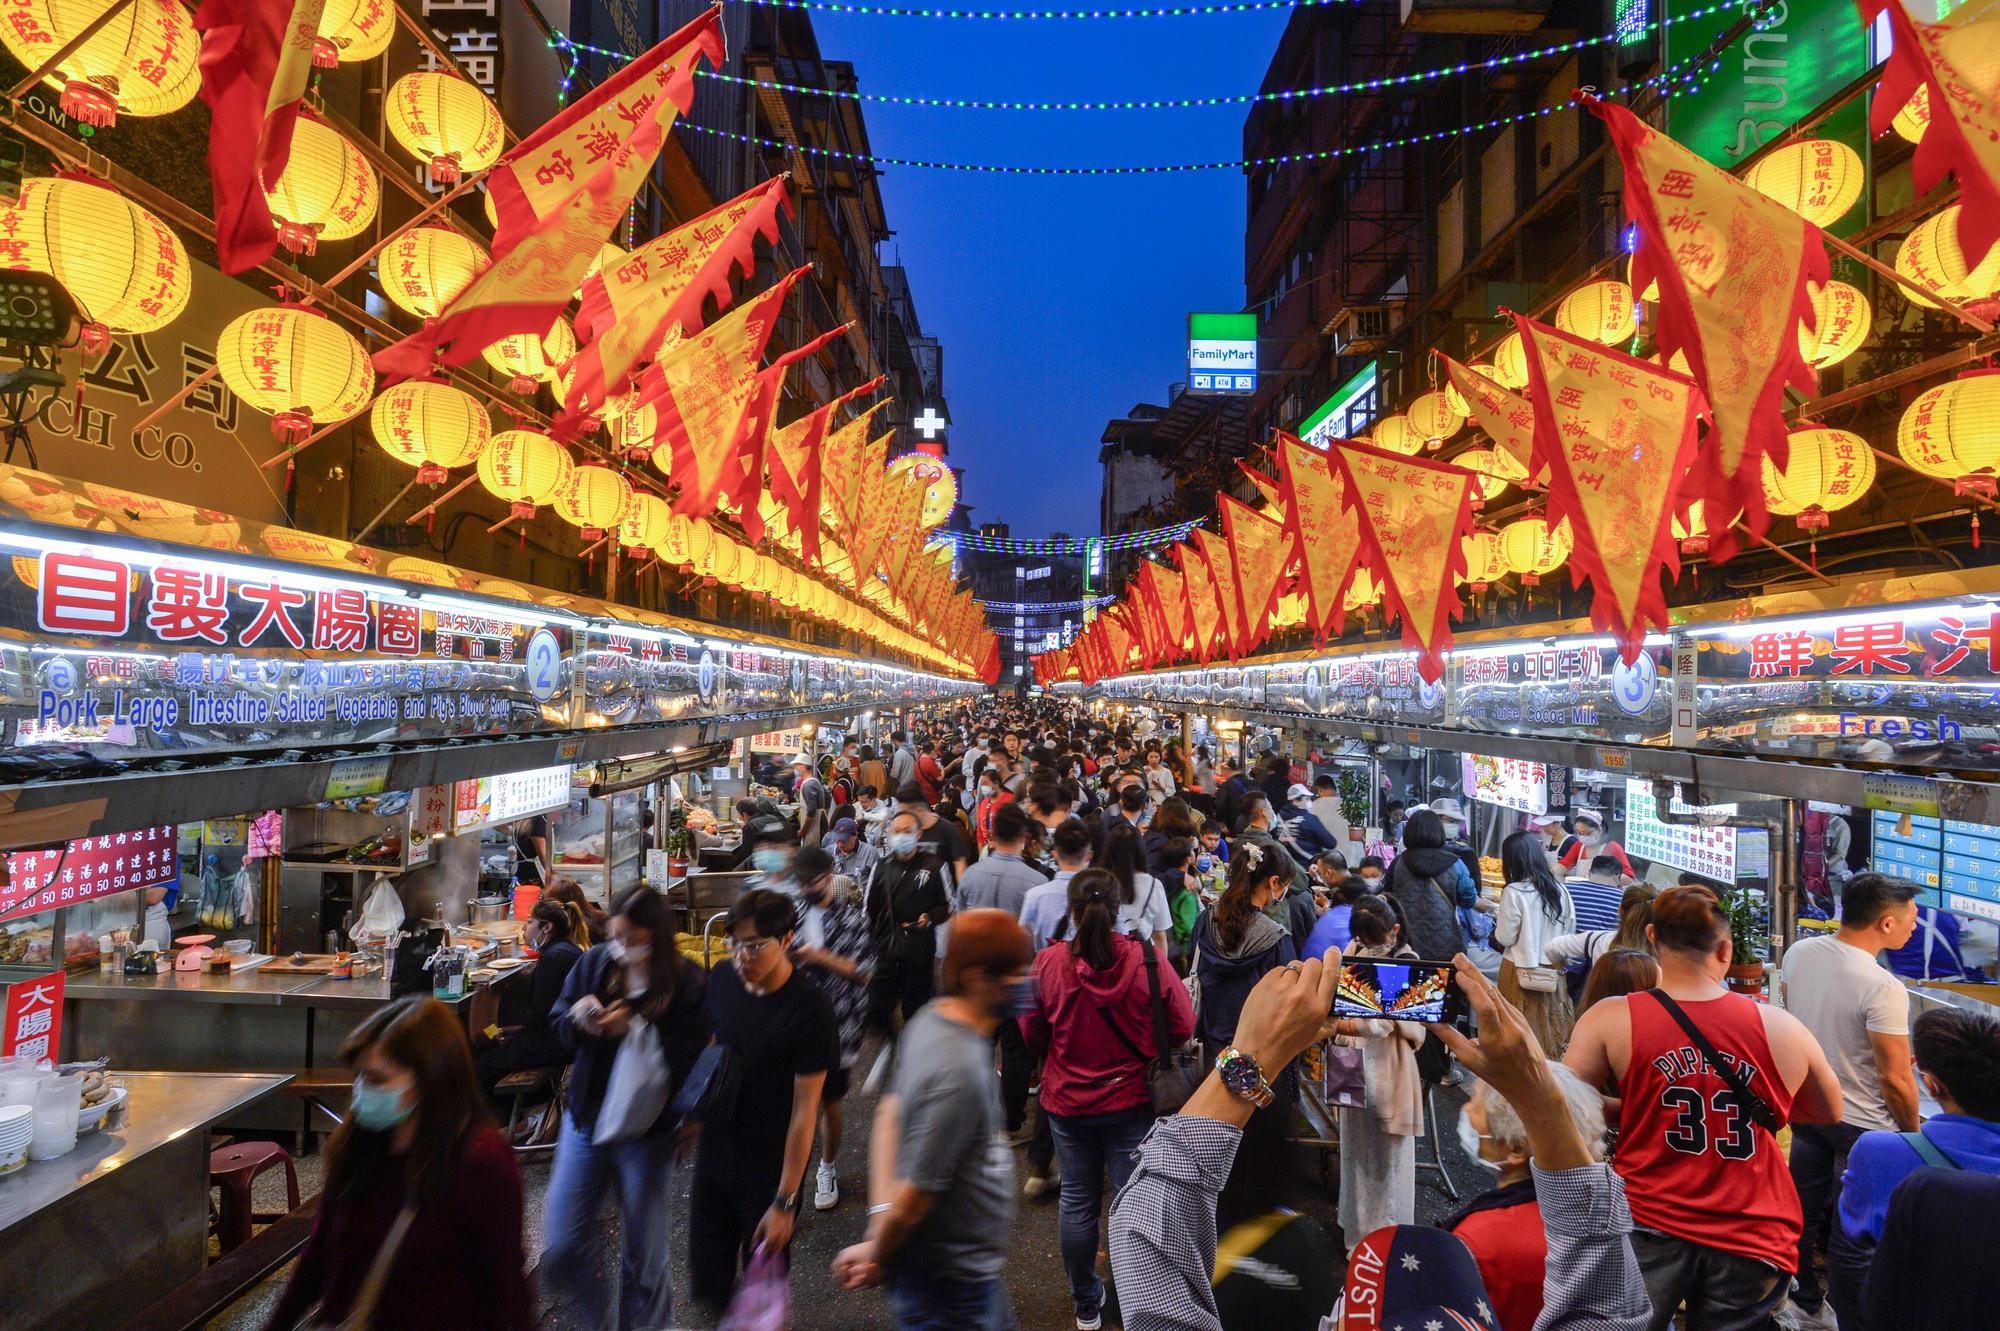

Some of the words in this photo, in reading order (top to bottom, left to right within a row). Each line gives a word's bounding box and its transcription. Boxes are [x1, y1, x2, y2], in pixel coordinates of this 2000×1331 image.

[1822, 290, 1856, 347] 開漳聖王
[252, 322, 287, 393] 開漳聖王
[1192, 348, 1254, 362] FamilyMart
[1217, 378, 1229, 387] ATM
[391, 397, 421, 454] 開漳聖王
[131, 425, 203, 473] CO.
[1827, 432, 1857, 496] 歡迎光臨
[39, 550, 422, 656] 自製大腸圈
[436, 632, 513, 662] 豬血湯
[536, 644, 551, 690] 2
[1623, 664, 1645, 704] 3
[39, 690, 101, 729] Pork
[113, 691, 179, 732] Large
[335, 693, 398, 725] Vegetable
[405, 695, 425, 718] and
[1527, 706, 1565, 724] Cocoa
[1571, 707, 1599, 726] Milk
[1839, 711, 1962, 741] Fresh
[1604, 755, 1625, 767] 1950
[130, 872, 141, 884] 40
[145, 868, 157, 881] 30
[160, 864, 171, 877] 30
[1928, 875, 1937, 884] 60
[79, 883, 92, 896] 50
[97, 879, 109, 892] 50
[113, 875, 126, 888] 50
[42, 890, 55, 905] 50
[61, 886, 74, 900] 50
[1661, 1086, 1756, 1162] 33
